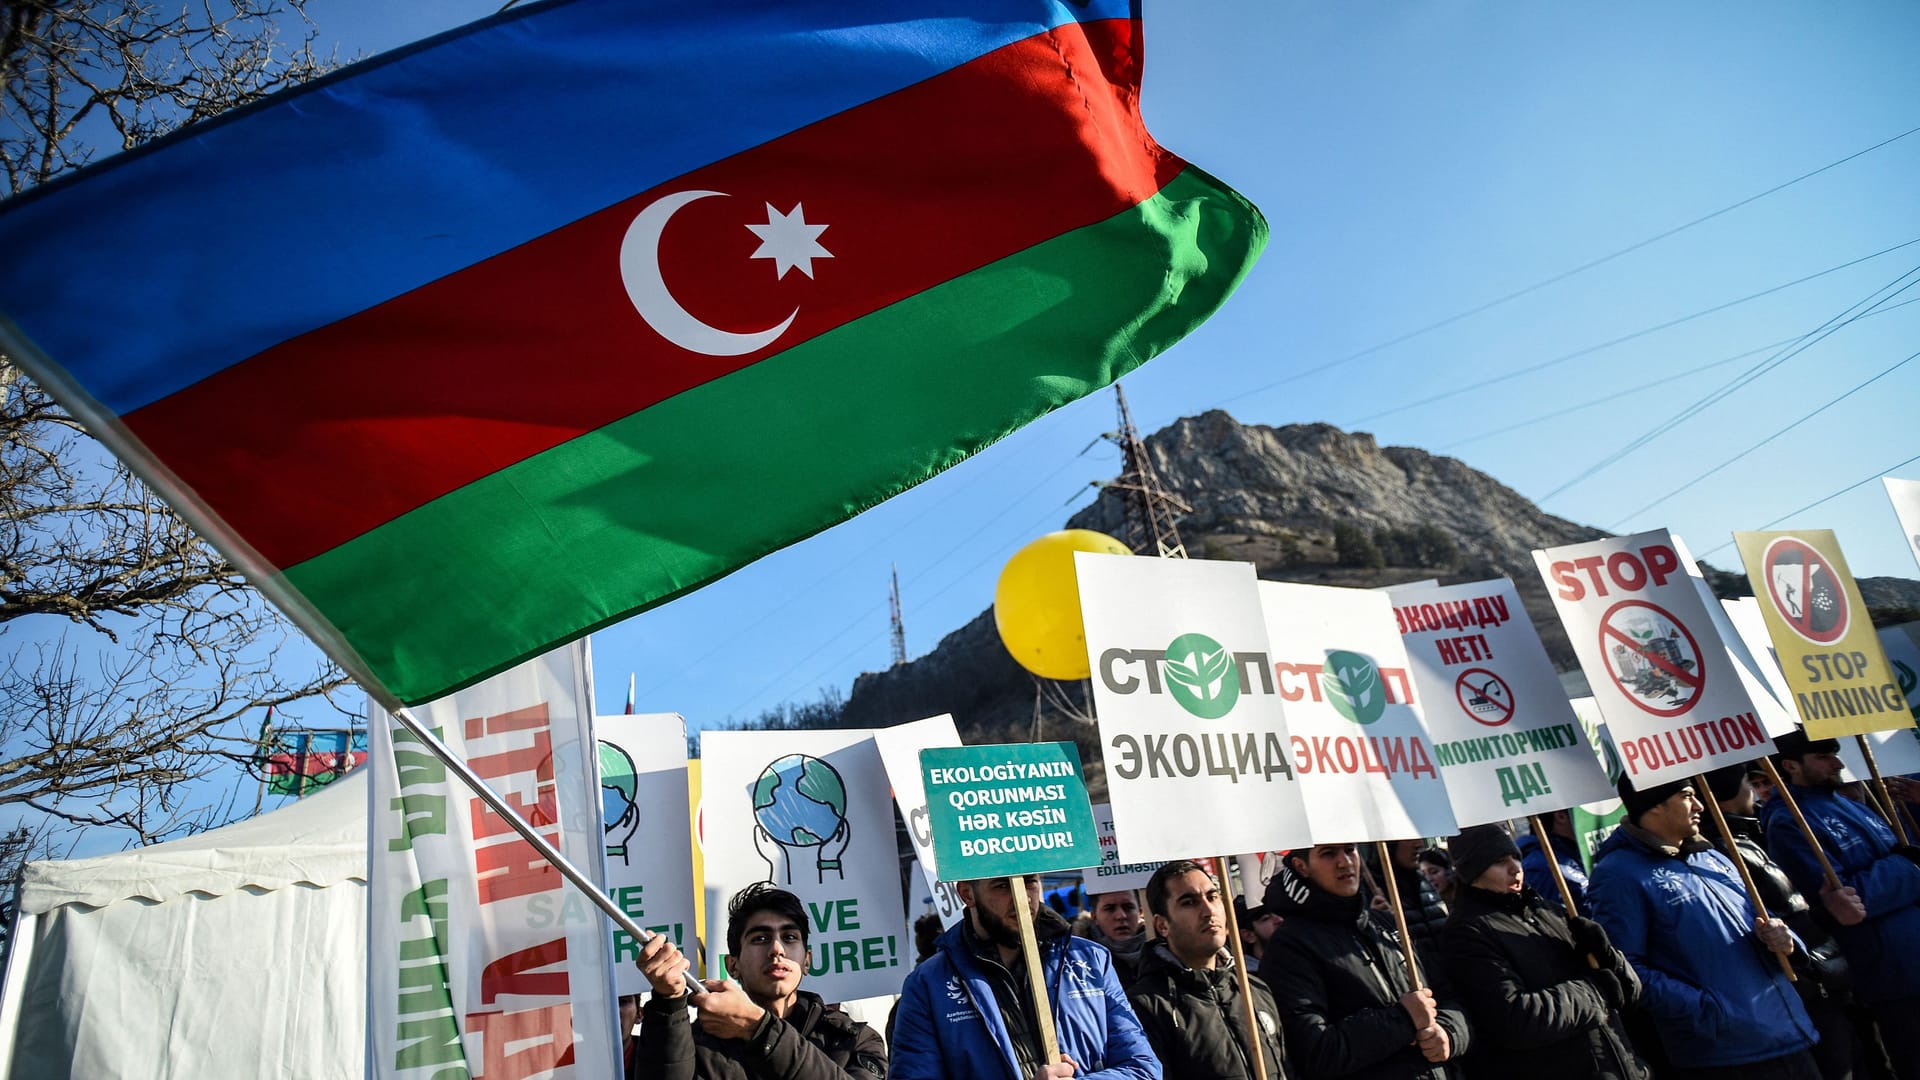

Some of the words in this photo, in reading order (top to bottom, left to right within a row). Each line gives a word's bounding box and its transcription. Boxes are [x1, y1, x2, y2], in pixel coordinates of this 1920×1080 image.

[1550, 544, 1678, 602] STOP
[1393, 594, 1511, 635] ЭКОЦИДУ
[1435, 633, 1494, 666] НЕТ!
[1801, 651, 1868, 683] STOP
[1797, 683, 1904, 721] MINING
[1111, 732, 1294, 784] ЭКОЦИД
[1290, 735, 1438, 780] ЭКОЦИД
[1433, 723, 1578, 767] МОНИТОРИНГУ
[1621, 712, 1766, 775] POLLUTION
[930, 761, 1075, 785] EKOLOGİYANIN
[1495, 762, 1553, 807] ДА!
[948, 785, 1067, 810] QORUNMASI
[958, 812, 1003, 832] HƏR
[1005, 805, 1067, 828] KƏSİN
[960, 831, 1074, 857] BORCUDUR!
